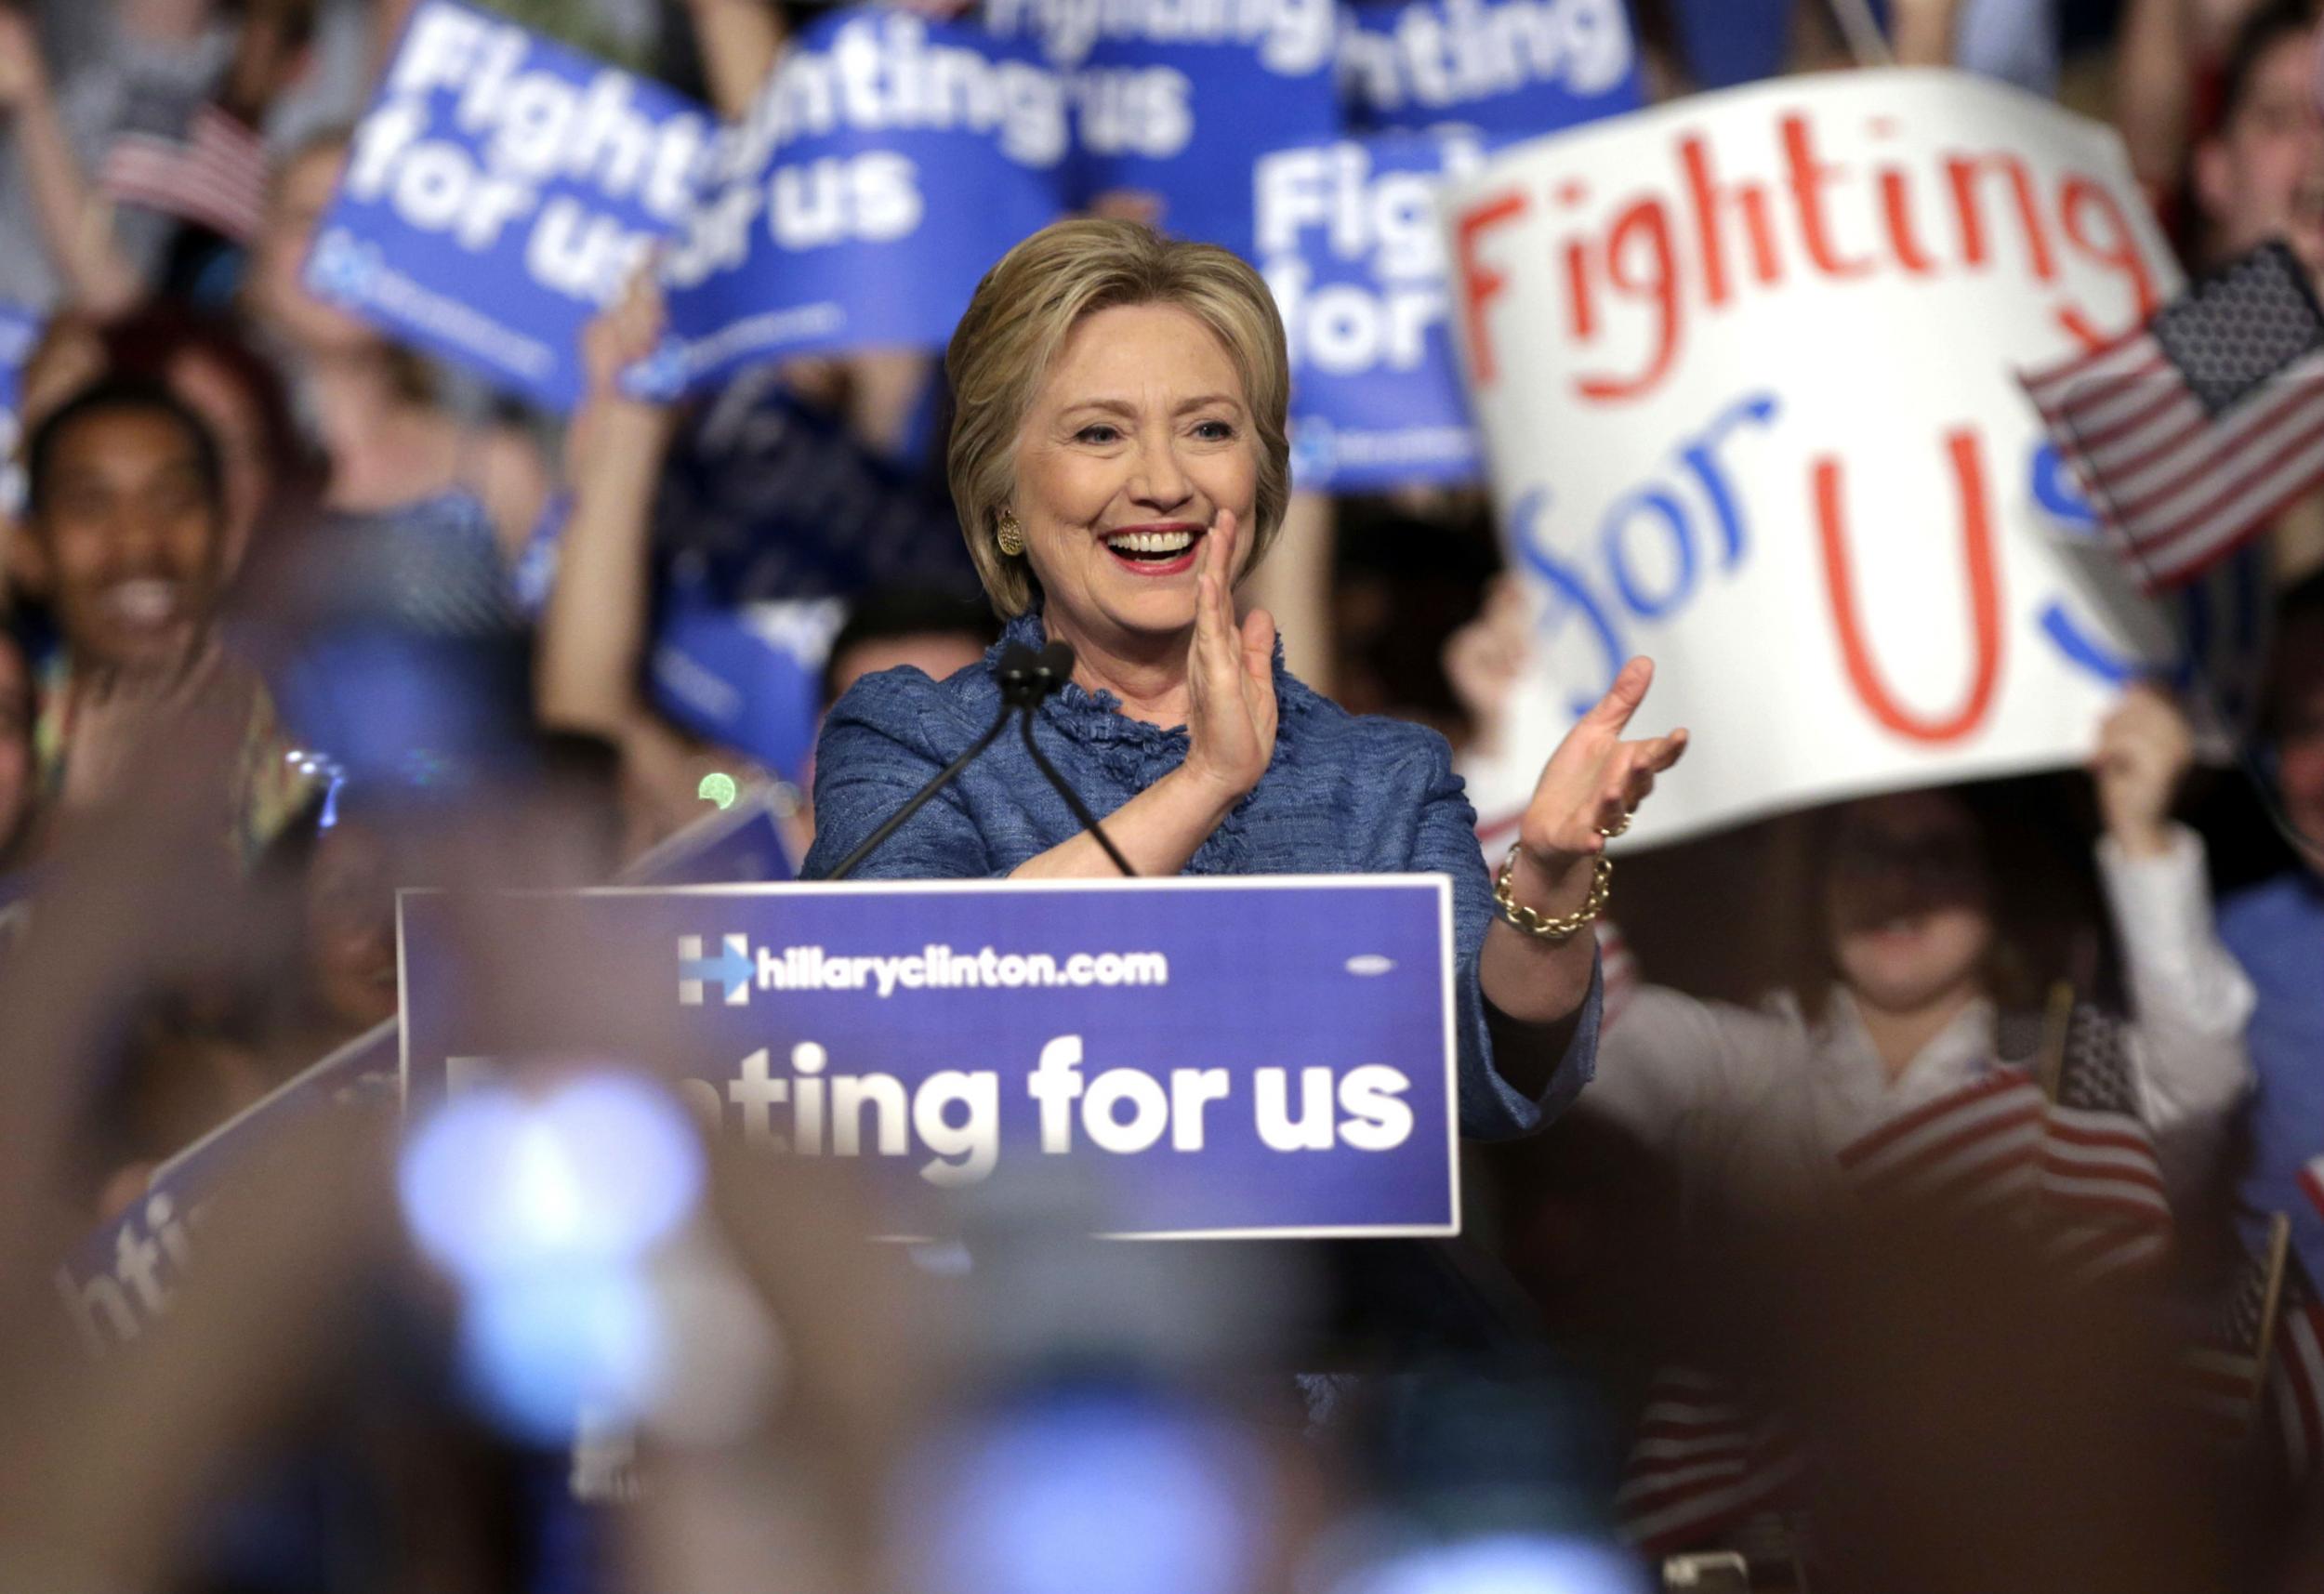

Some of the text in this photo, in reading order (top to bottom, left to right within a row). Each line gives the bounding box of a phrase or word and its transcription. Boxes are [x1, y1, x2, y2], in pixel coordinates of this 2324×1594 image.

[340, 91, 539, 251] for
[769, 149, 924, 251] us
[1452, 108, 2168, 409] Fighting
[1508, 389, 1787, 727] for
[757, 944, 1169, 998] hillaryclinton.com
[1027, 1034, 1231, 1154] for
[1254, 1063, 1415, 1153] us
